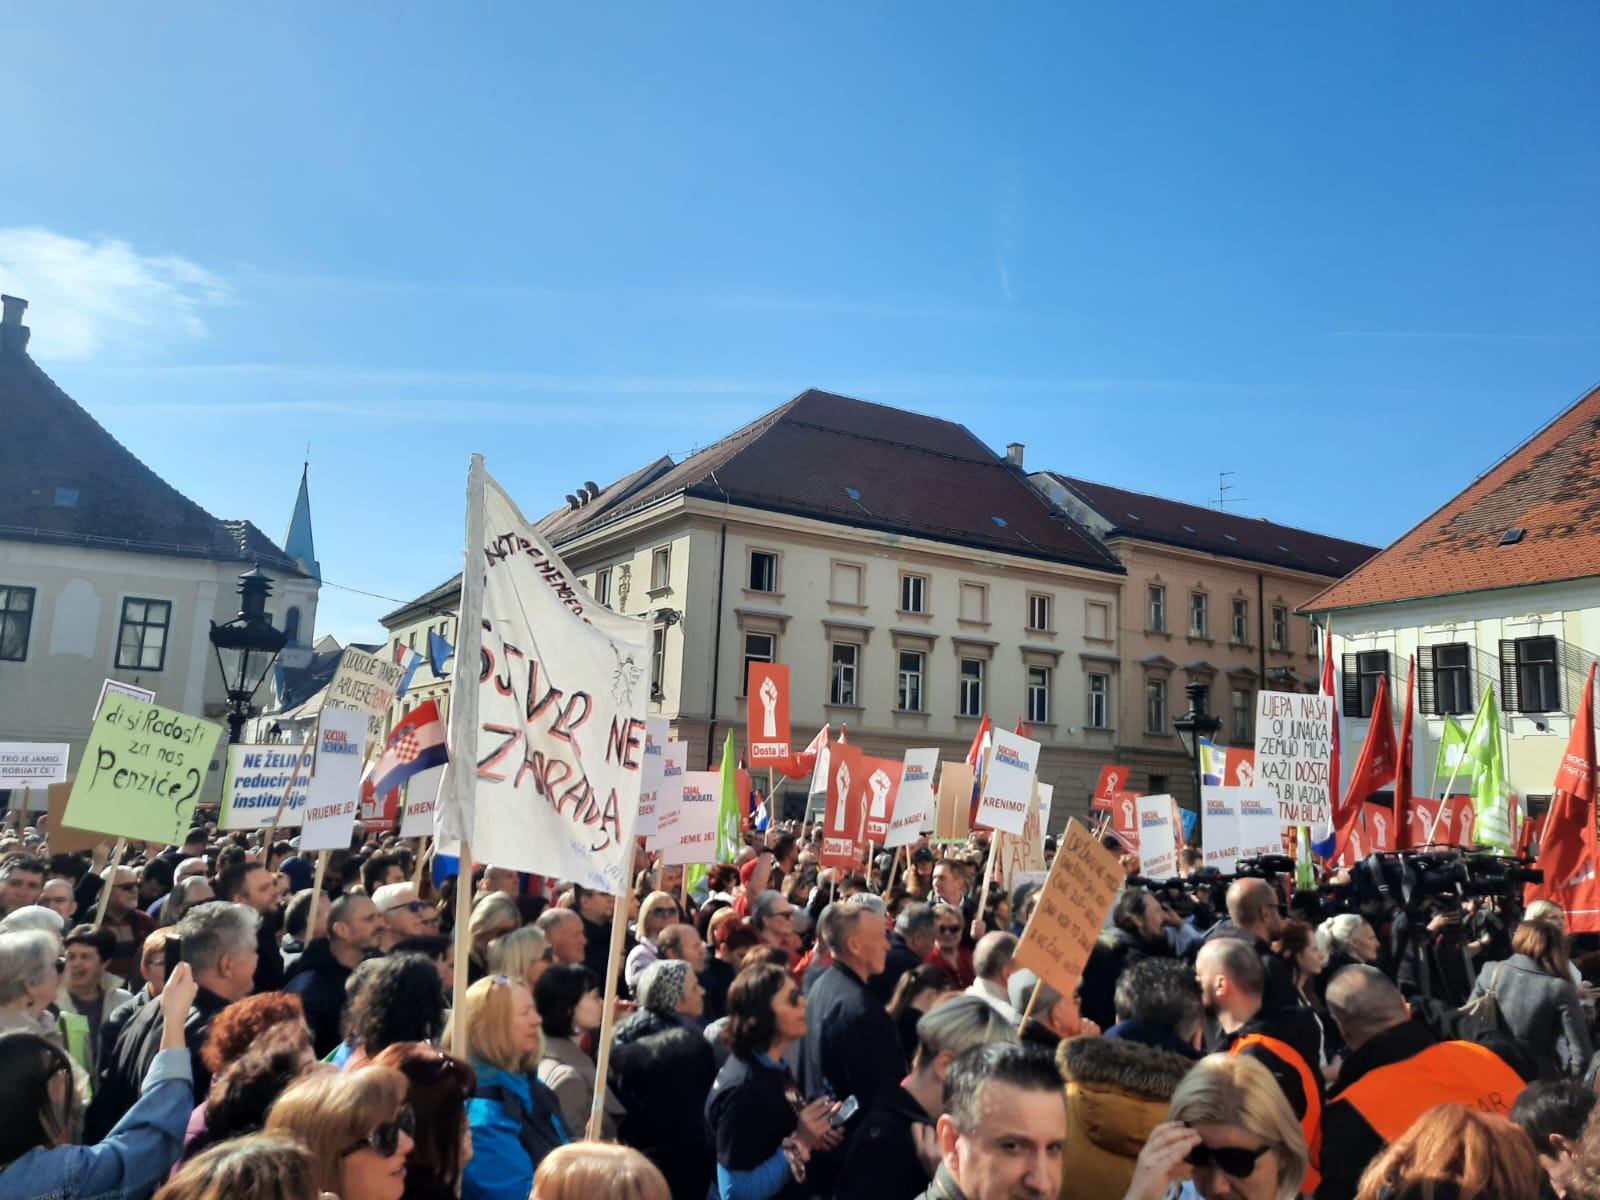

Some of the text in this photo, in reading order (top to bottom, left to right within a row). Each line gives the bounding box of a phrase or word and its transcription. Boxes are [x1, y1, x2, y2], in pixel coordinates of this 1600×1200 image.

[1301, 696, 1328, 721] NAŠA
[606, 715, 647, 770] NE
[753, 743, 788, 758] Dosta je!
[1303, 740, 1329, 759] MILA
[1, 755, 59, 763] TKO JE JAMIO
[158, 748, 184, 767] nas
[243, 753, 263, 768] NE
[1262, 759, 1329, 786] KAŽI DOSTA
[232, 791, 306, 811] instituije
[407, 800, 436, 817] KRENI
[983, 796, 1026, 812] KRENIMO!
[307, 804, 342, 820] VRIJEME
[1278, 801, 1325, 822] TNA BILA
